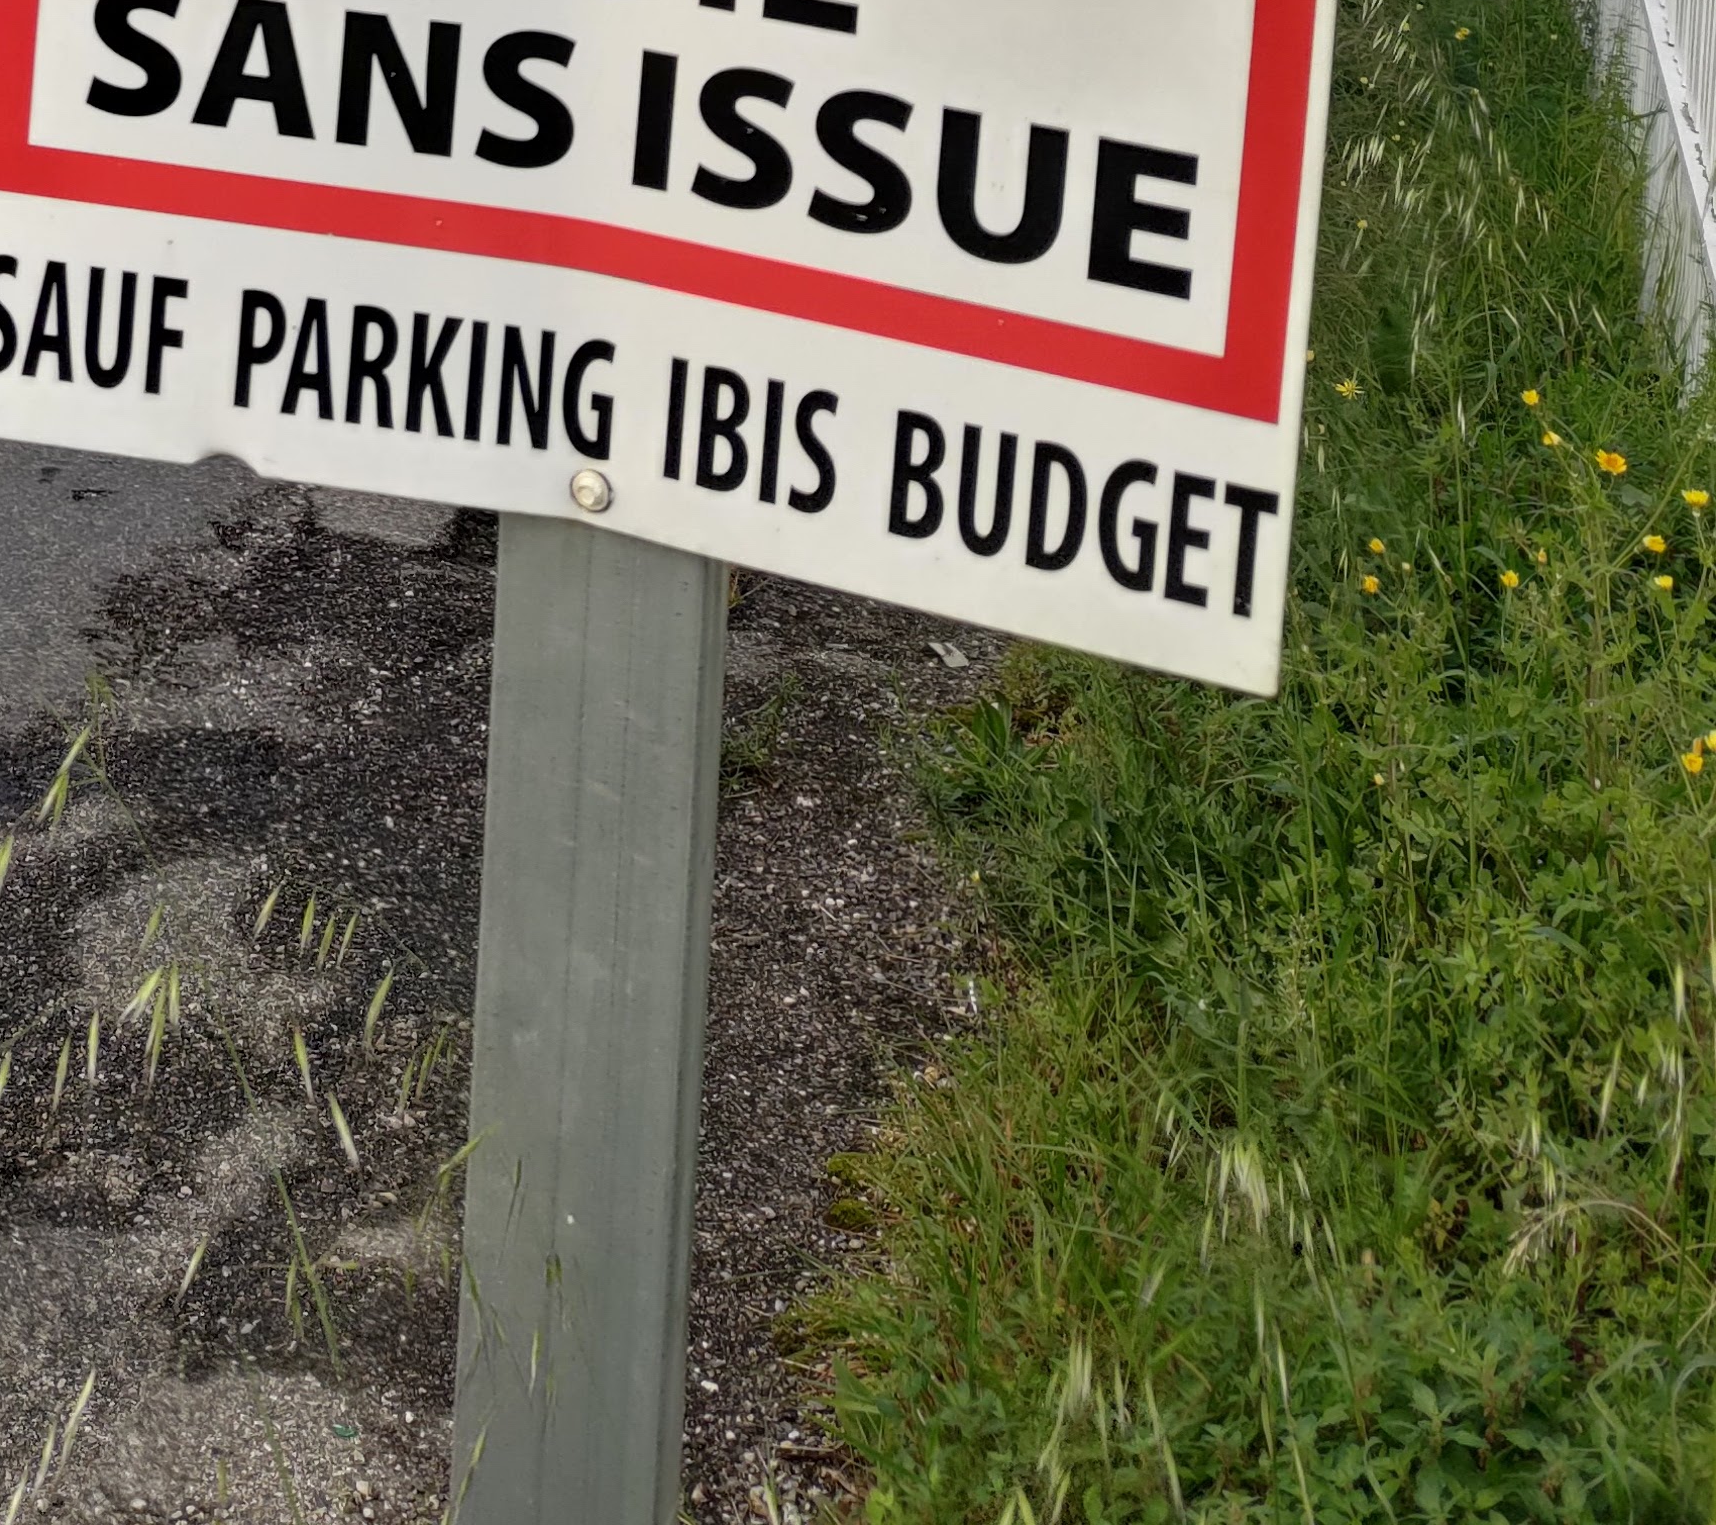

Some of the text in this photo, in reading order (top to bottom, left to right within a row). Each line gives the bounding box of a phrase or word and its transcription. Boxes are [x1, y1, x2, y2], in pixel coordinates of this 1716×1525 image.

[630, 49, 1200, 302] ISSUE
[232, 288, 617, 462] PARKING
[662, 356, 840, 515] IBIS
[887, 408, 1280, 619] BUDGET
